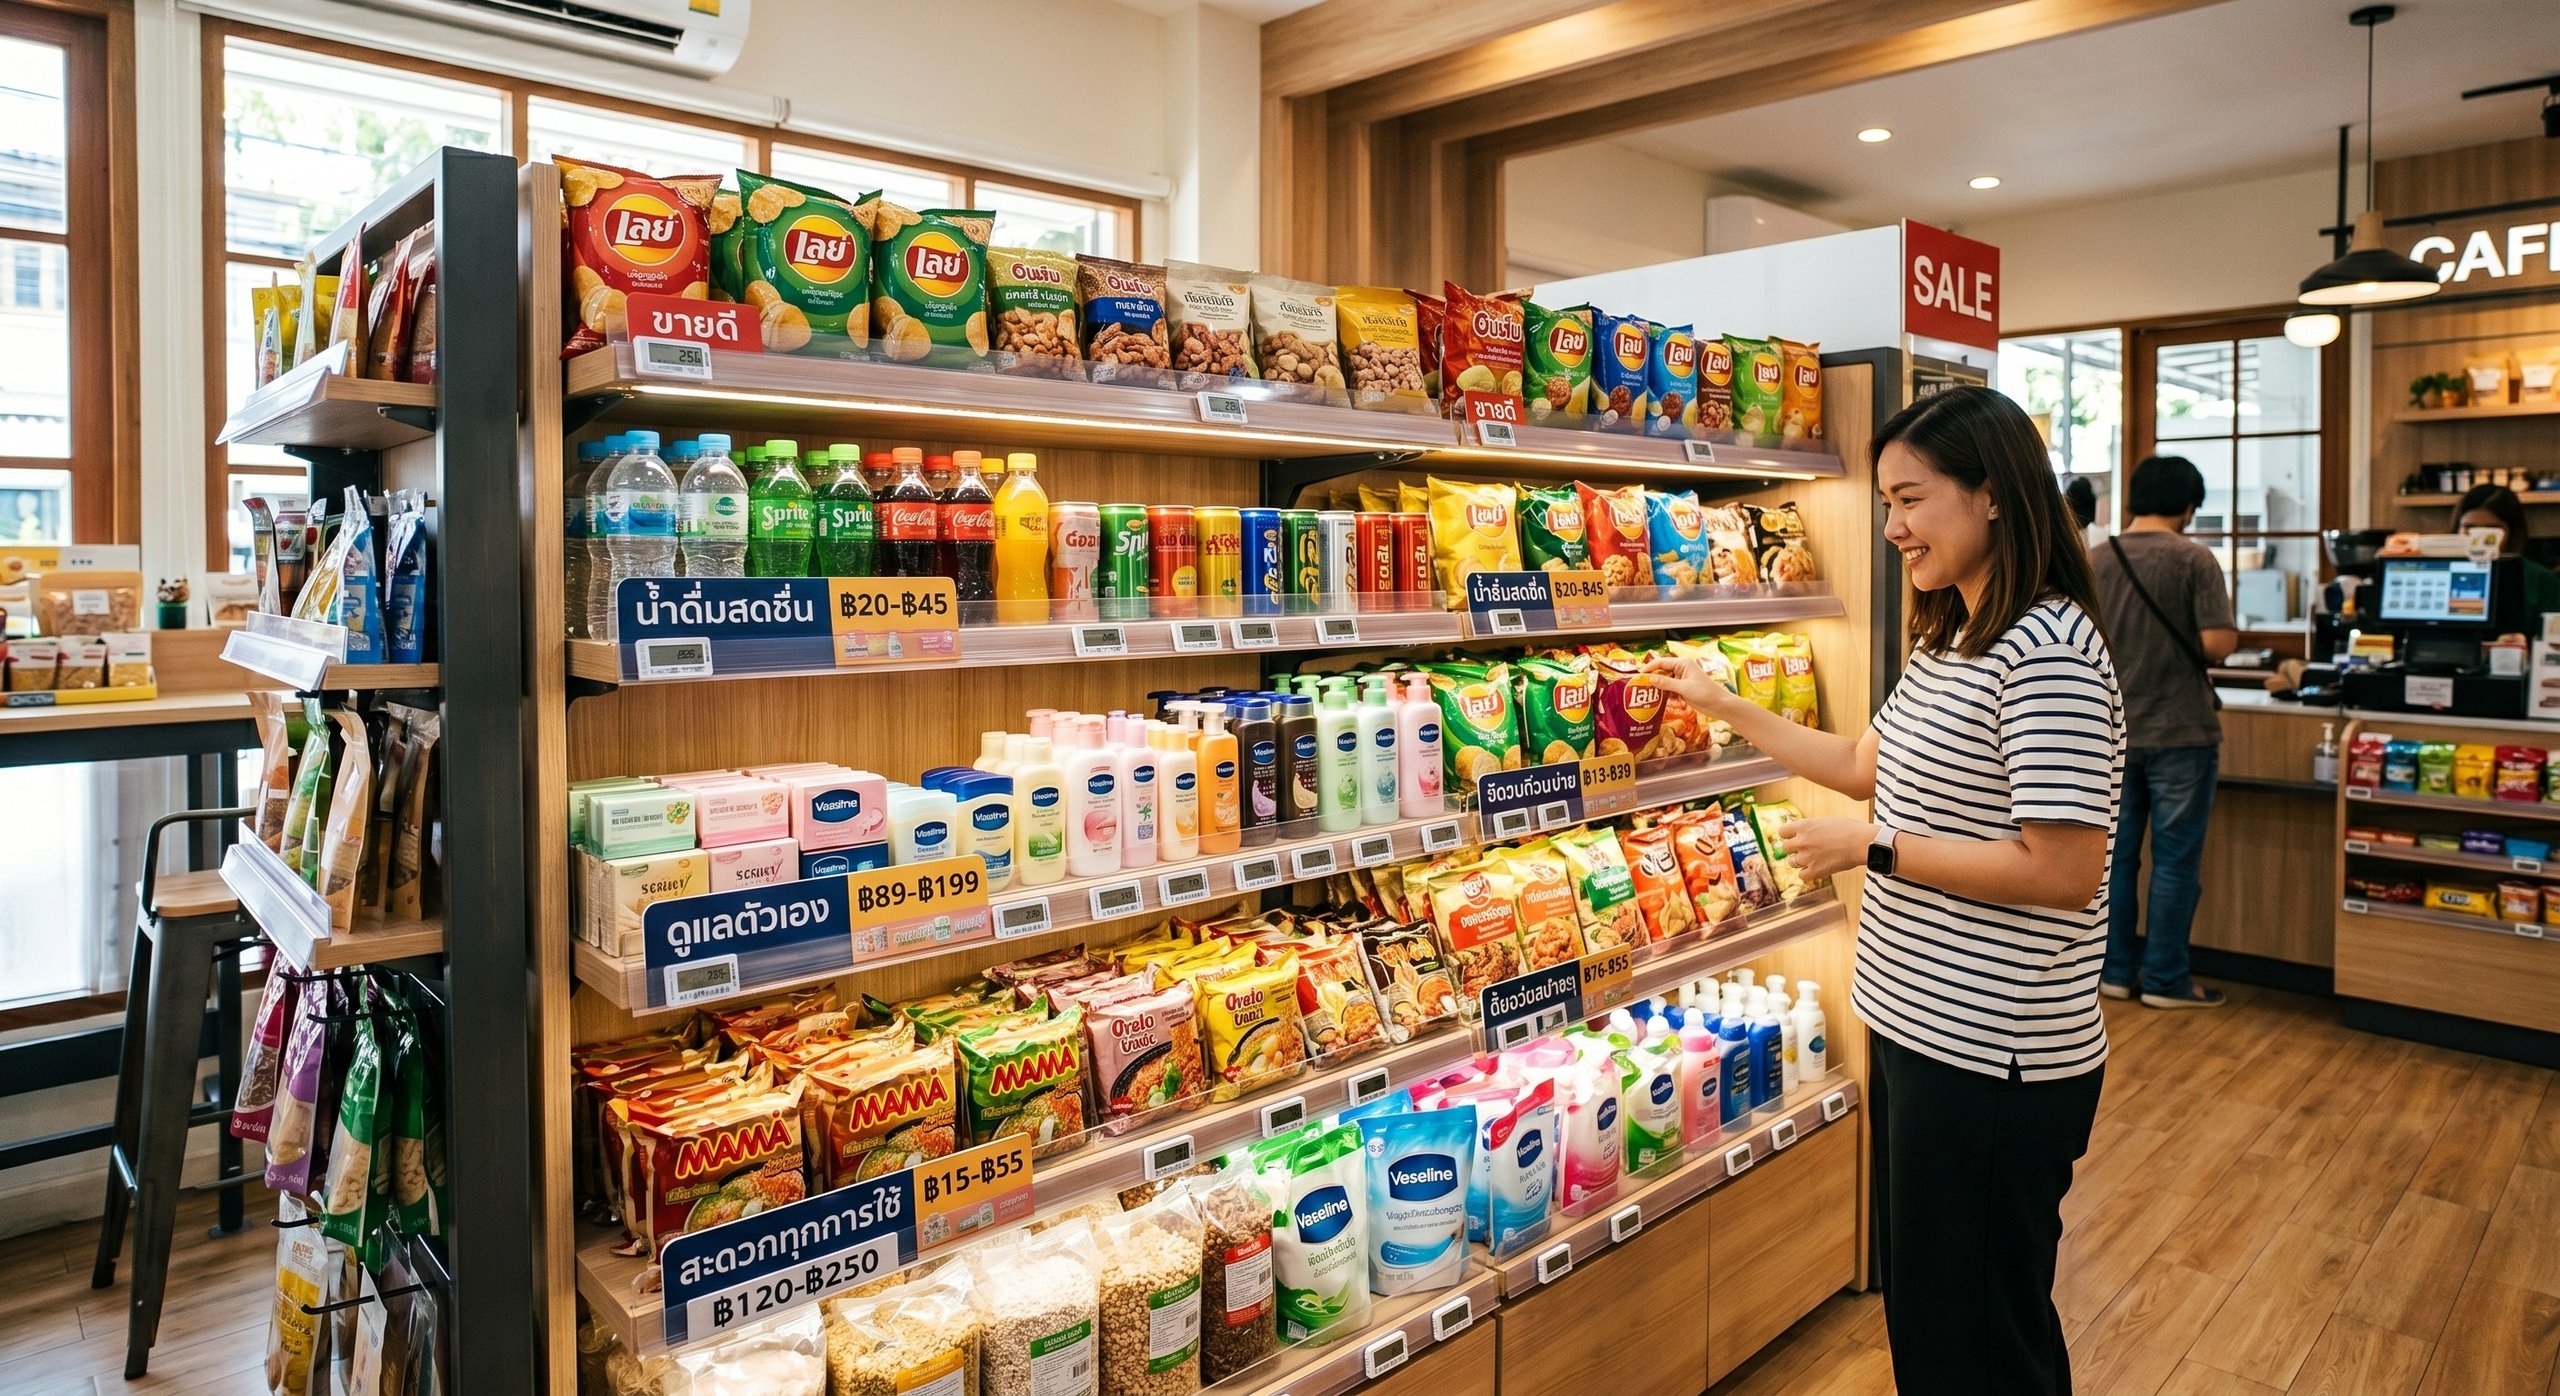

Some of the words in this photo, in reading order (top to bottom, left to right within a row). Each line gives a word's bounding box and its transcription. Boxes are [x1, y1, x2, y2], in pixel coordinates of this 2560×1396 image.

[1913, 255, 1993, 322] SALE
[652, 309, 739, 342] ขายดี
[1474, 397, 1517, 421] ขายดี
[762, 503, 809, 529] Sprite
[636, 581, 814, 626] น้ำดื่มสดชื่น
[840, 591, 948, 619] ฿20-฿45
[667, 898, 830, 958] ดูแลตัวเอง
[857, 870, 980, 913] ฿89-฿199
[679, 1184, 902, 1286] สะดวกทุกการใช้
[923, 1150, 1025, 1204] ฿15-฿55
[712, 1248, 880, 1329] ฿120-฿250
